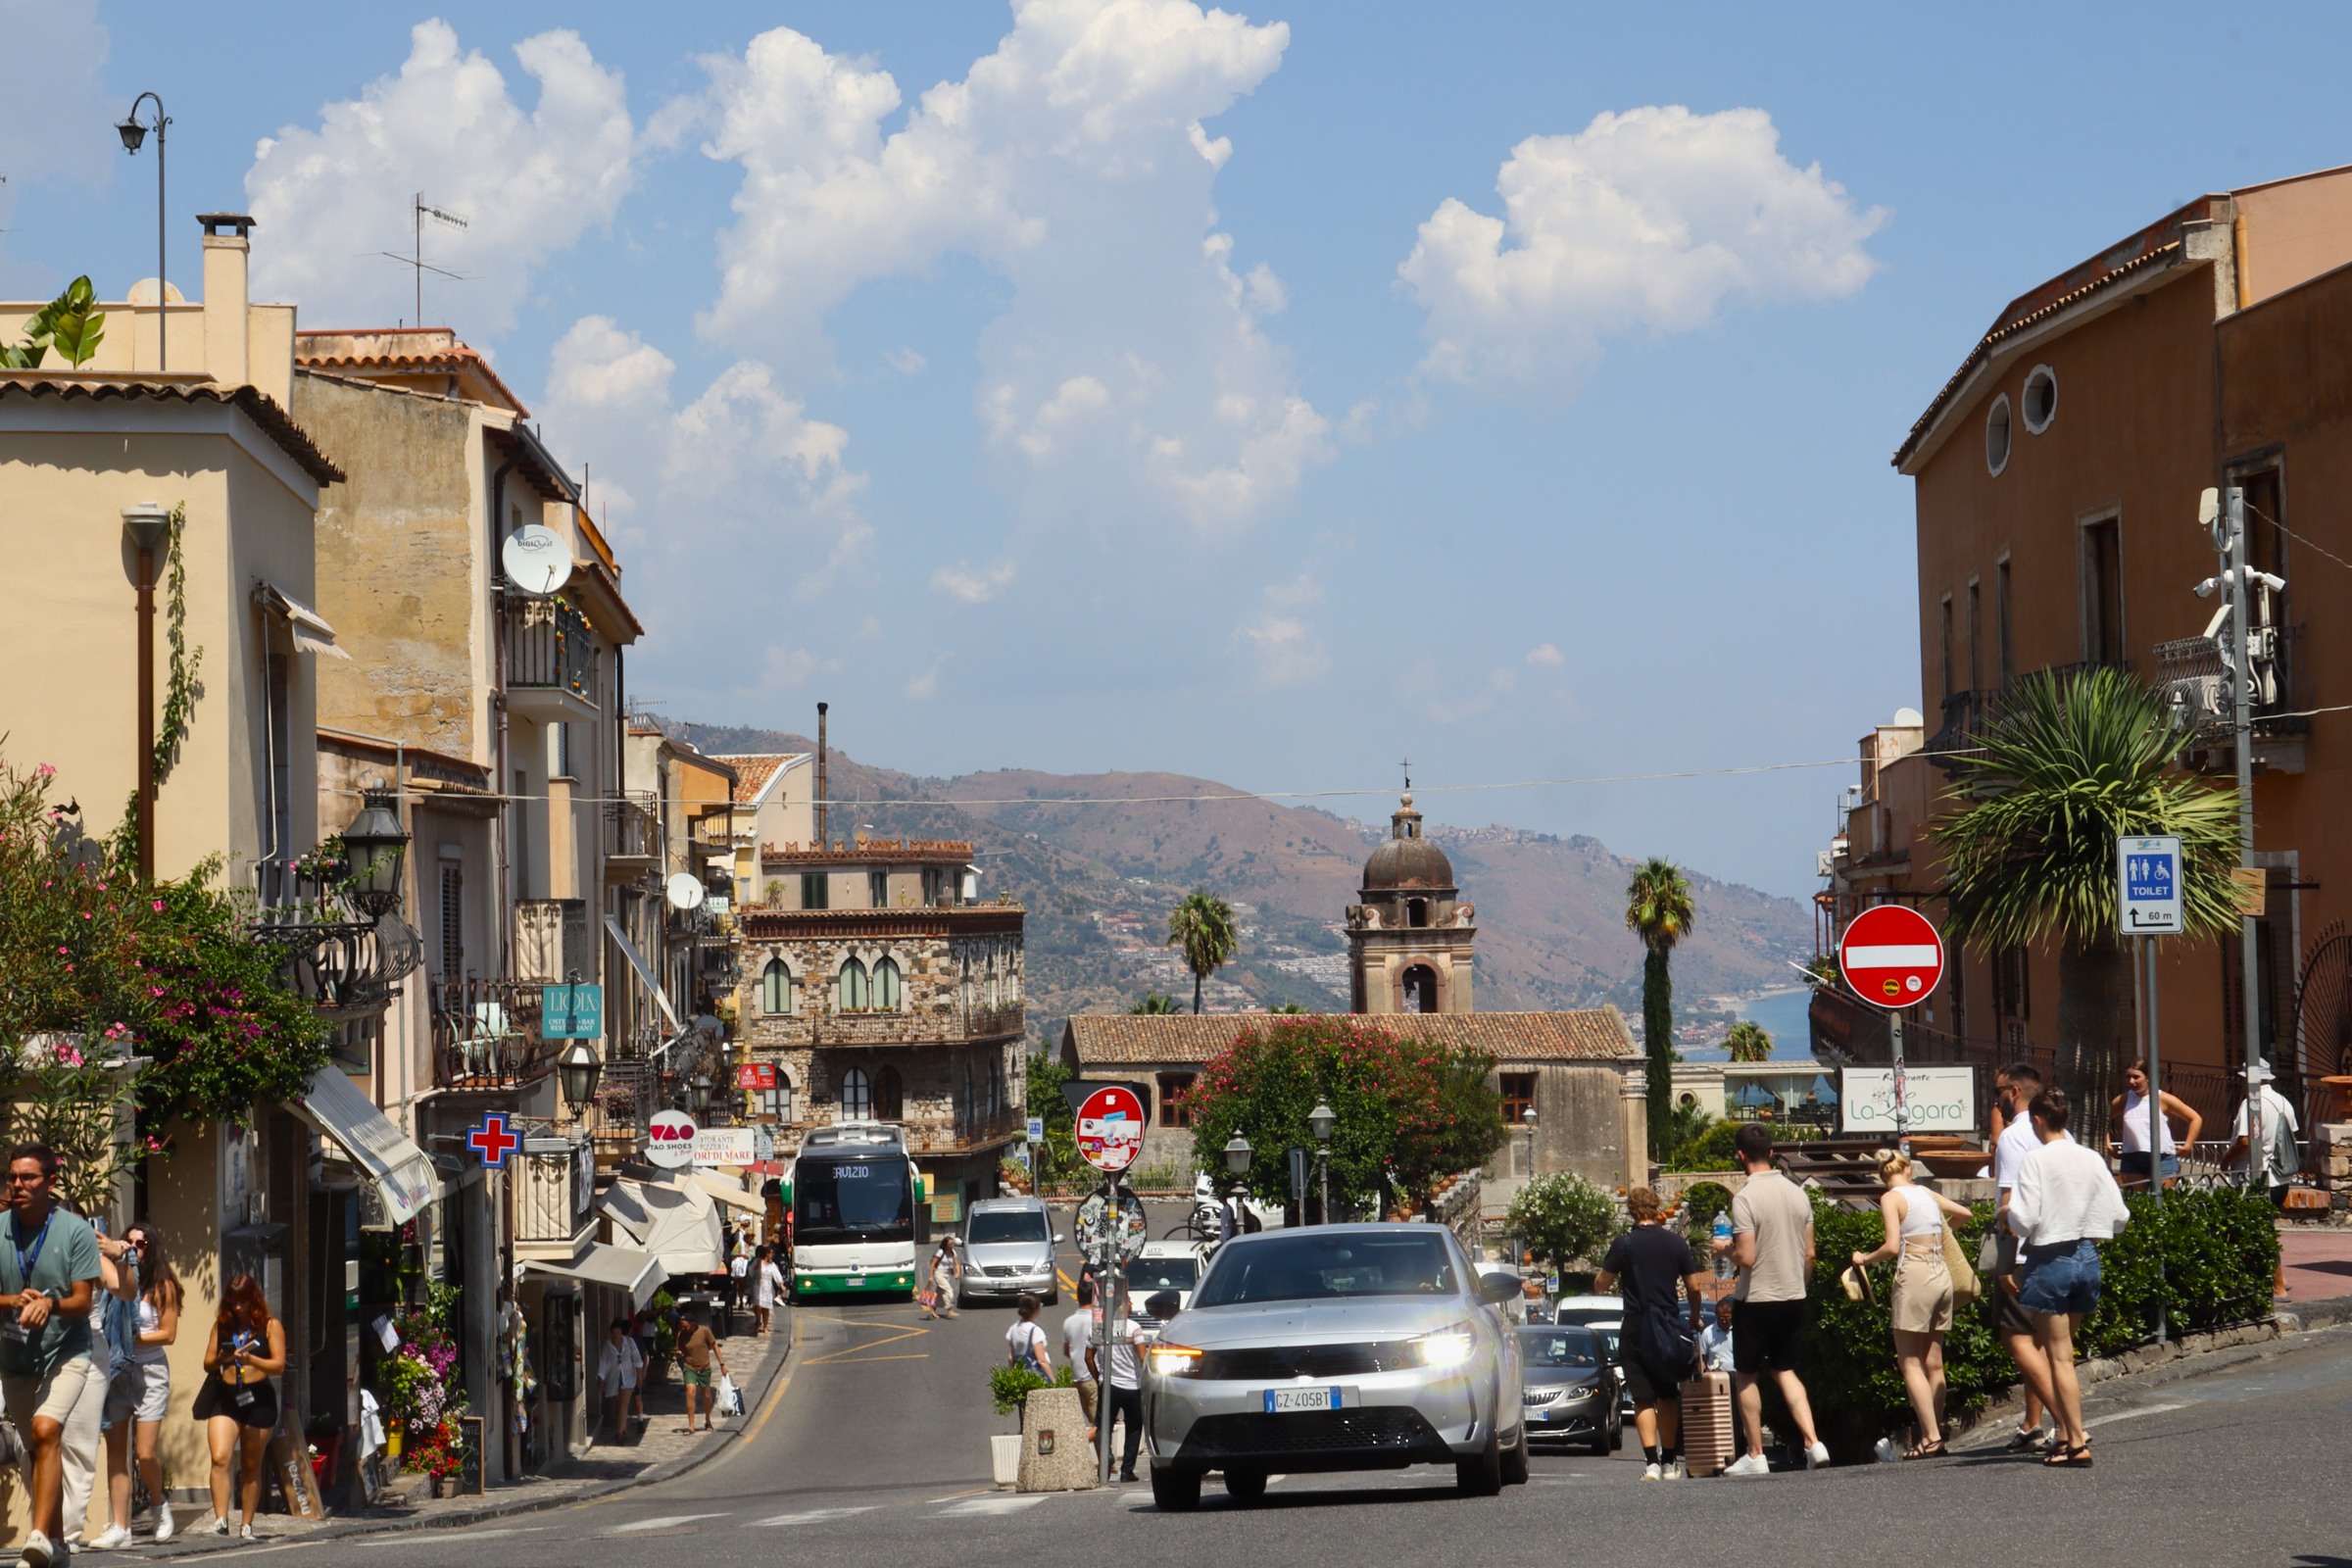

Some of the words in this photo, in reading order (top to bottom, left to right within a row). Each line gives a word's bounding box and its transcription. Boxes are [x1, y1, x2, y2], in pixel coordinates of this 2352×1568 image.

[2132, 887, 2169, 896] TOILET
[2148, 911, 2160, 920] 60
[1883, 1072, 1931, 1081] Rirante
[1850, 1100, 1875, 1120] La
[1876, 1091, 1962, 1125] gara
[694, 1152, 710, 1161] ORI
[713, 1152, 722, 1160] DI
[725, 1151, 752, 1160] MARE
[1276, 1394, 1290, 1408] GZ
[1295, 1392, 1329, 1407] 405BT
[284, 1459, 311, 1515] mayoral
